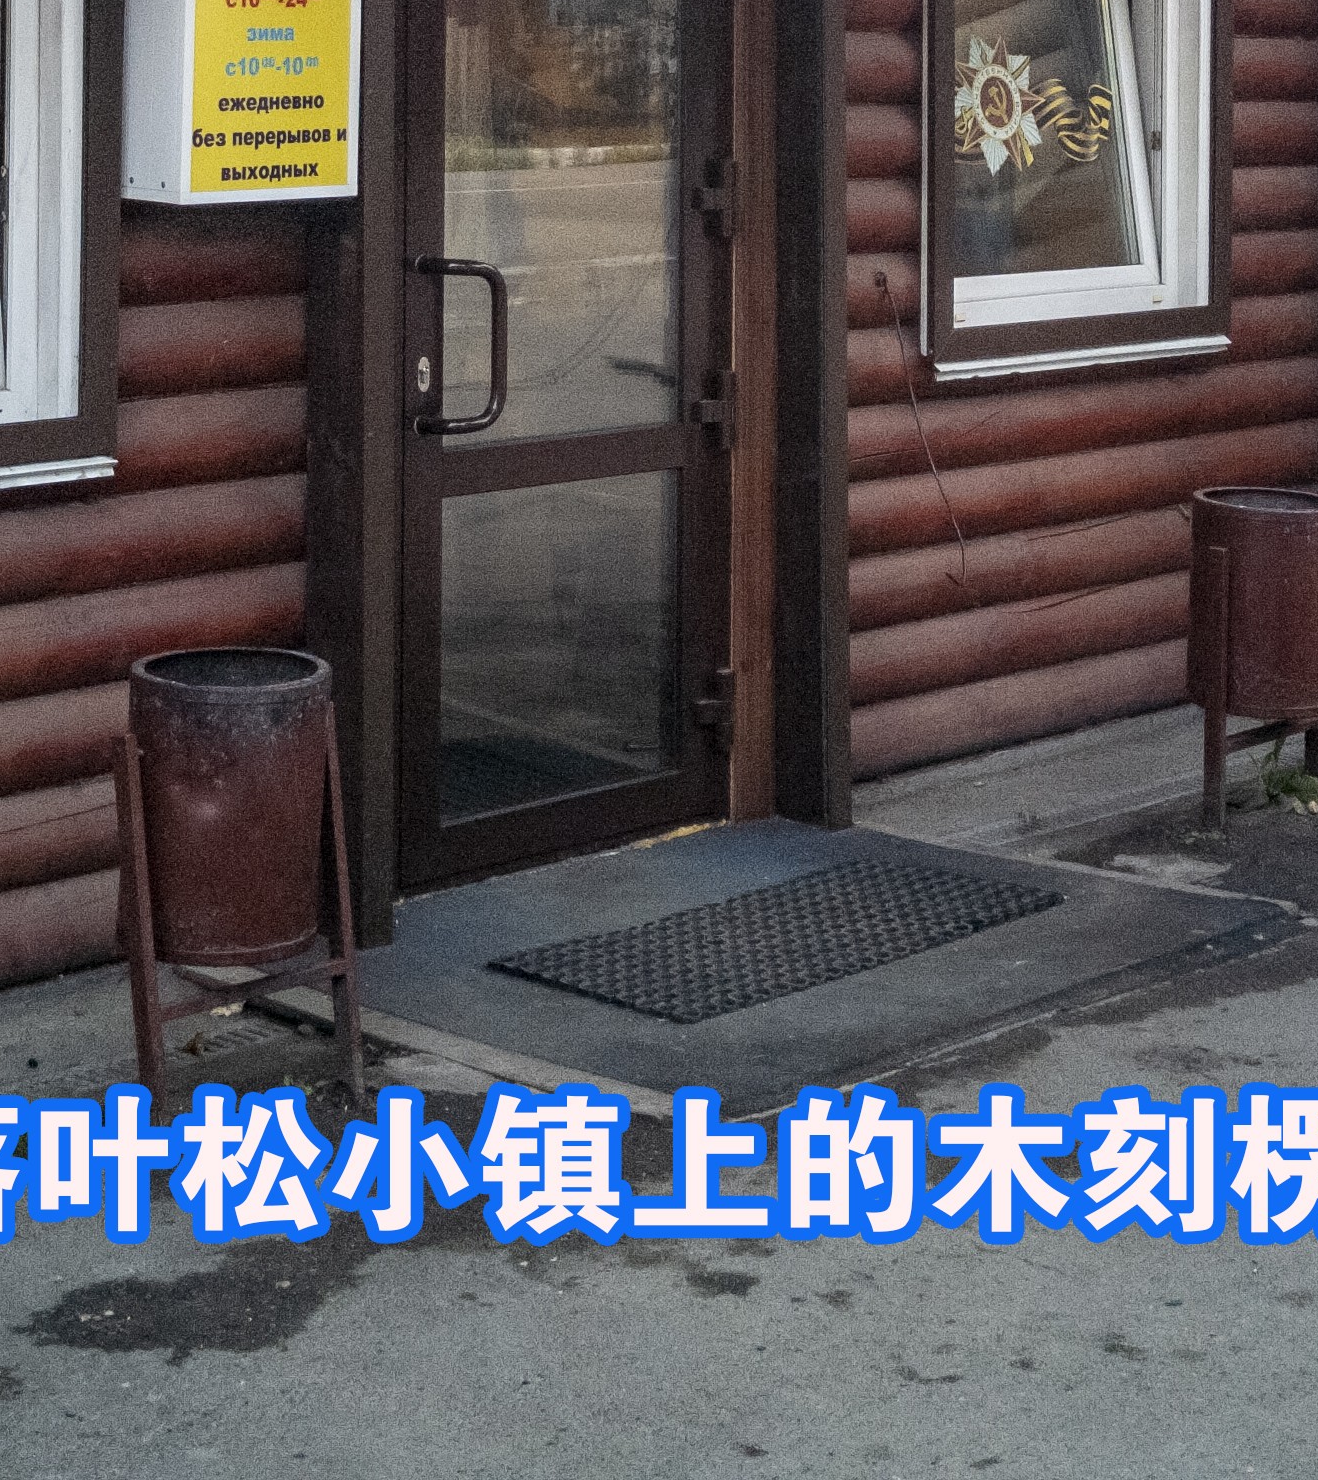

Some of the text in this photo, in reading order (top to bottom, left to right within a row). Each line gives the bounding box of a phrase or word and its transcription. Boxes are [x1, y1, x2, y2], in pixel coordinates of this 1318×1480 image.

[246, 27, 295, 42] зима
[218, 94, 325, 115] ежедневно
[192, 128, 347, 148] без перерывов и
[220, 161, 319, 181] выходных
